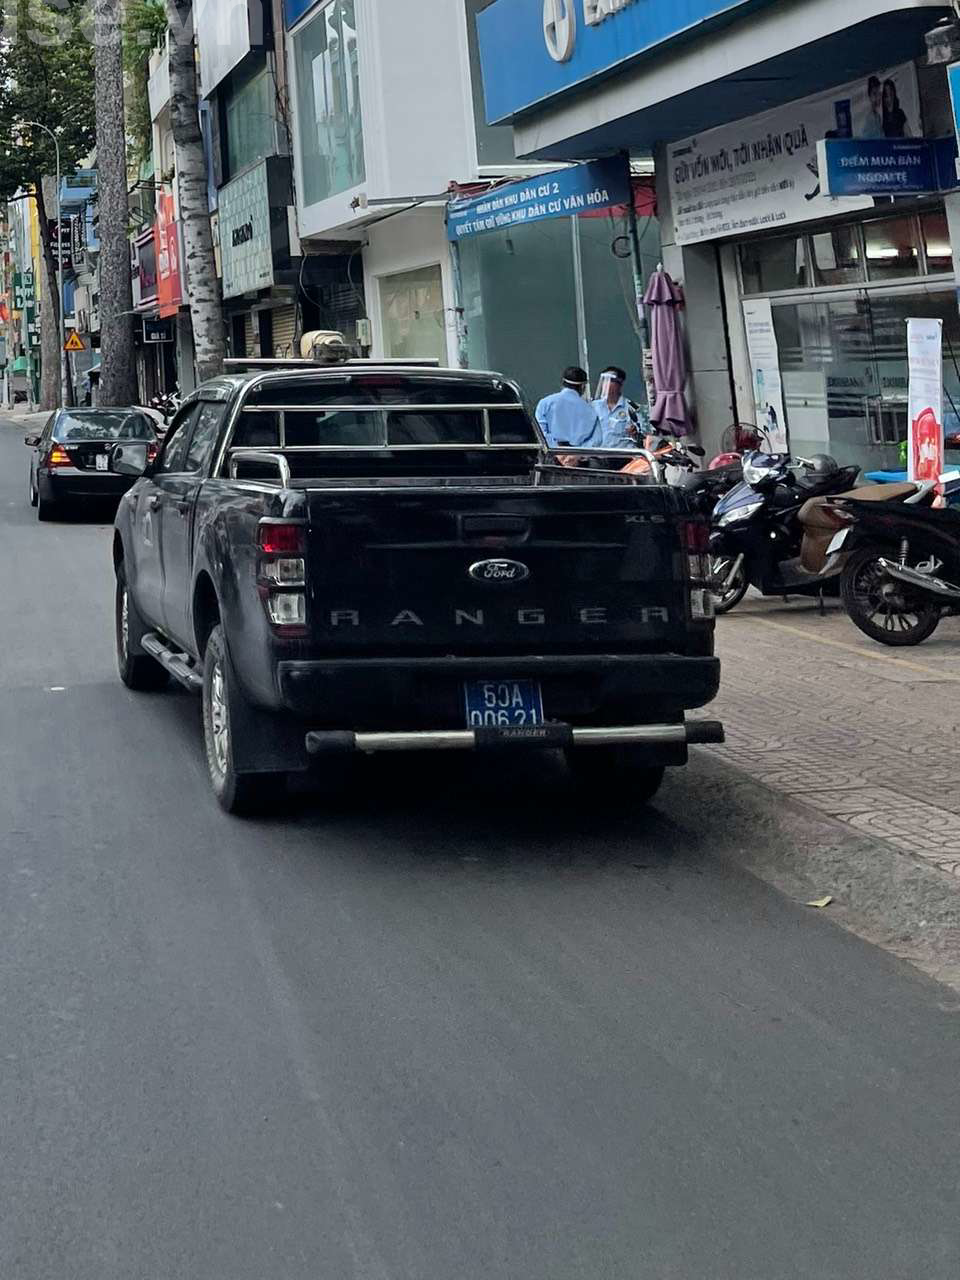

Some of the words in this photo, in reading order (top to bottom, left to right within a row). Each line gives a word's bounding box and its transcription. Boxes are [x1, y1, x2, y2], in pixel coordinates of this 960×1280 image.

[870, 156, 897, 167] MUA
[553, 183, 559, 194] 2
[482, 562, 516, 580] Ford
[330, 607, 669, 626] RANGER
